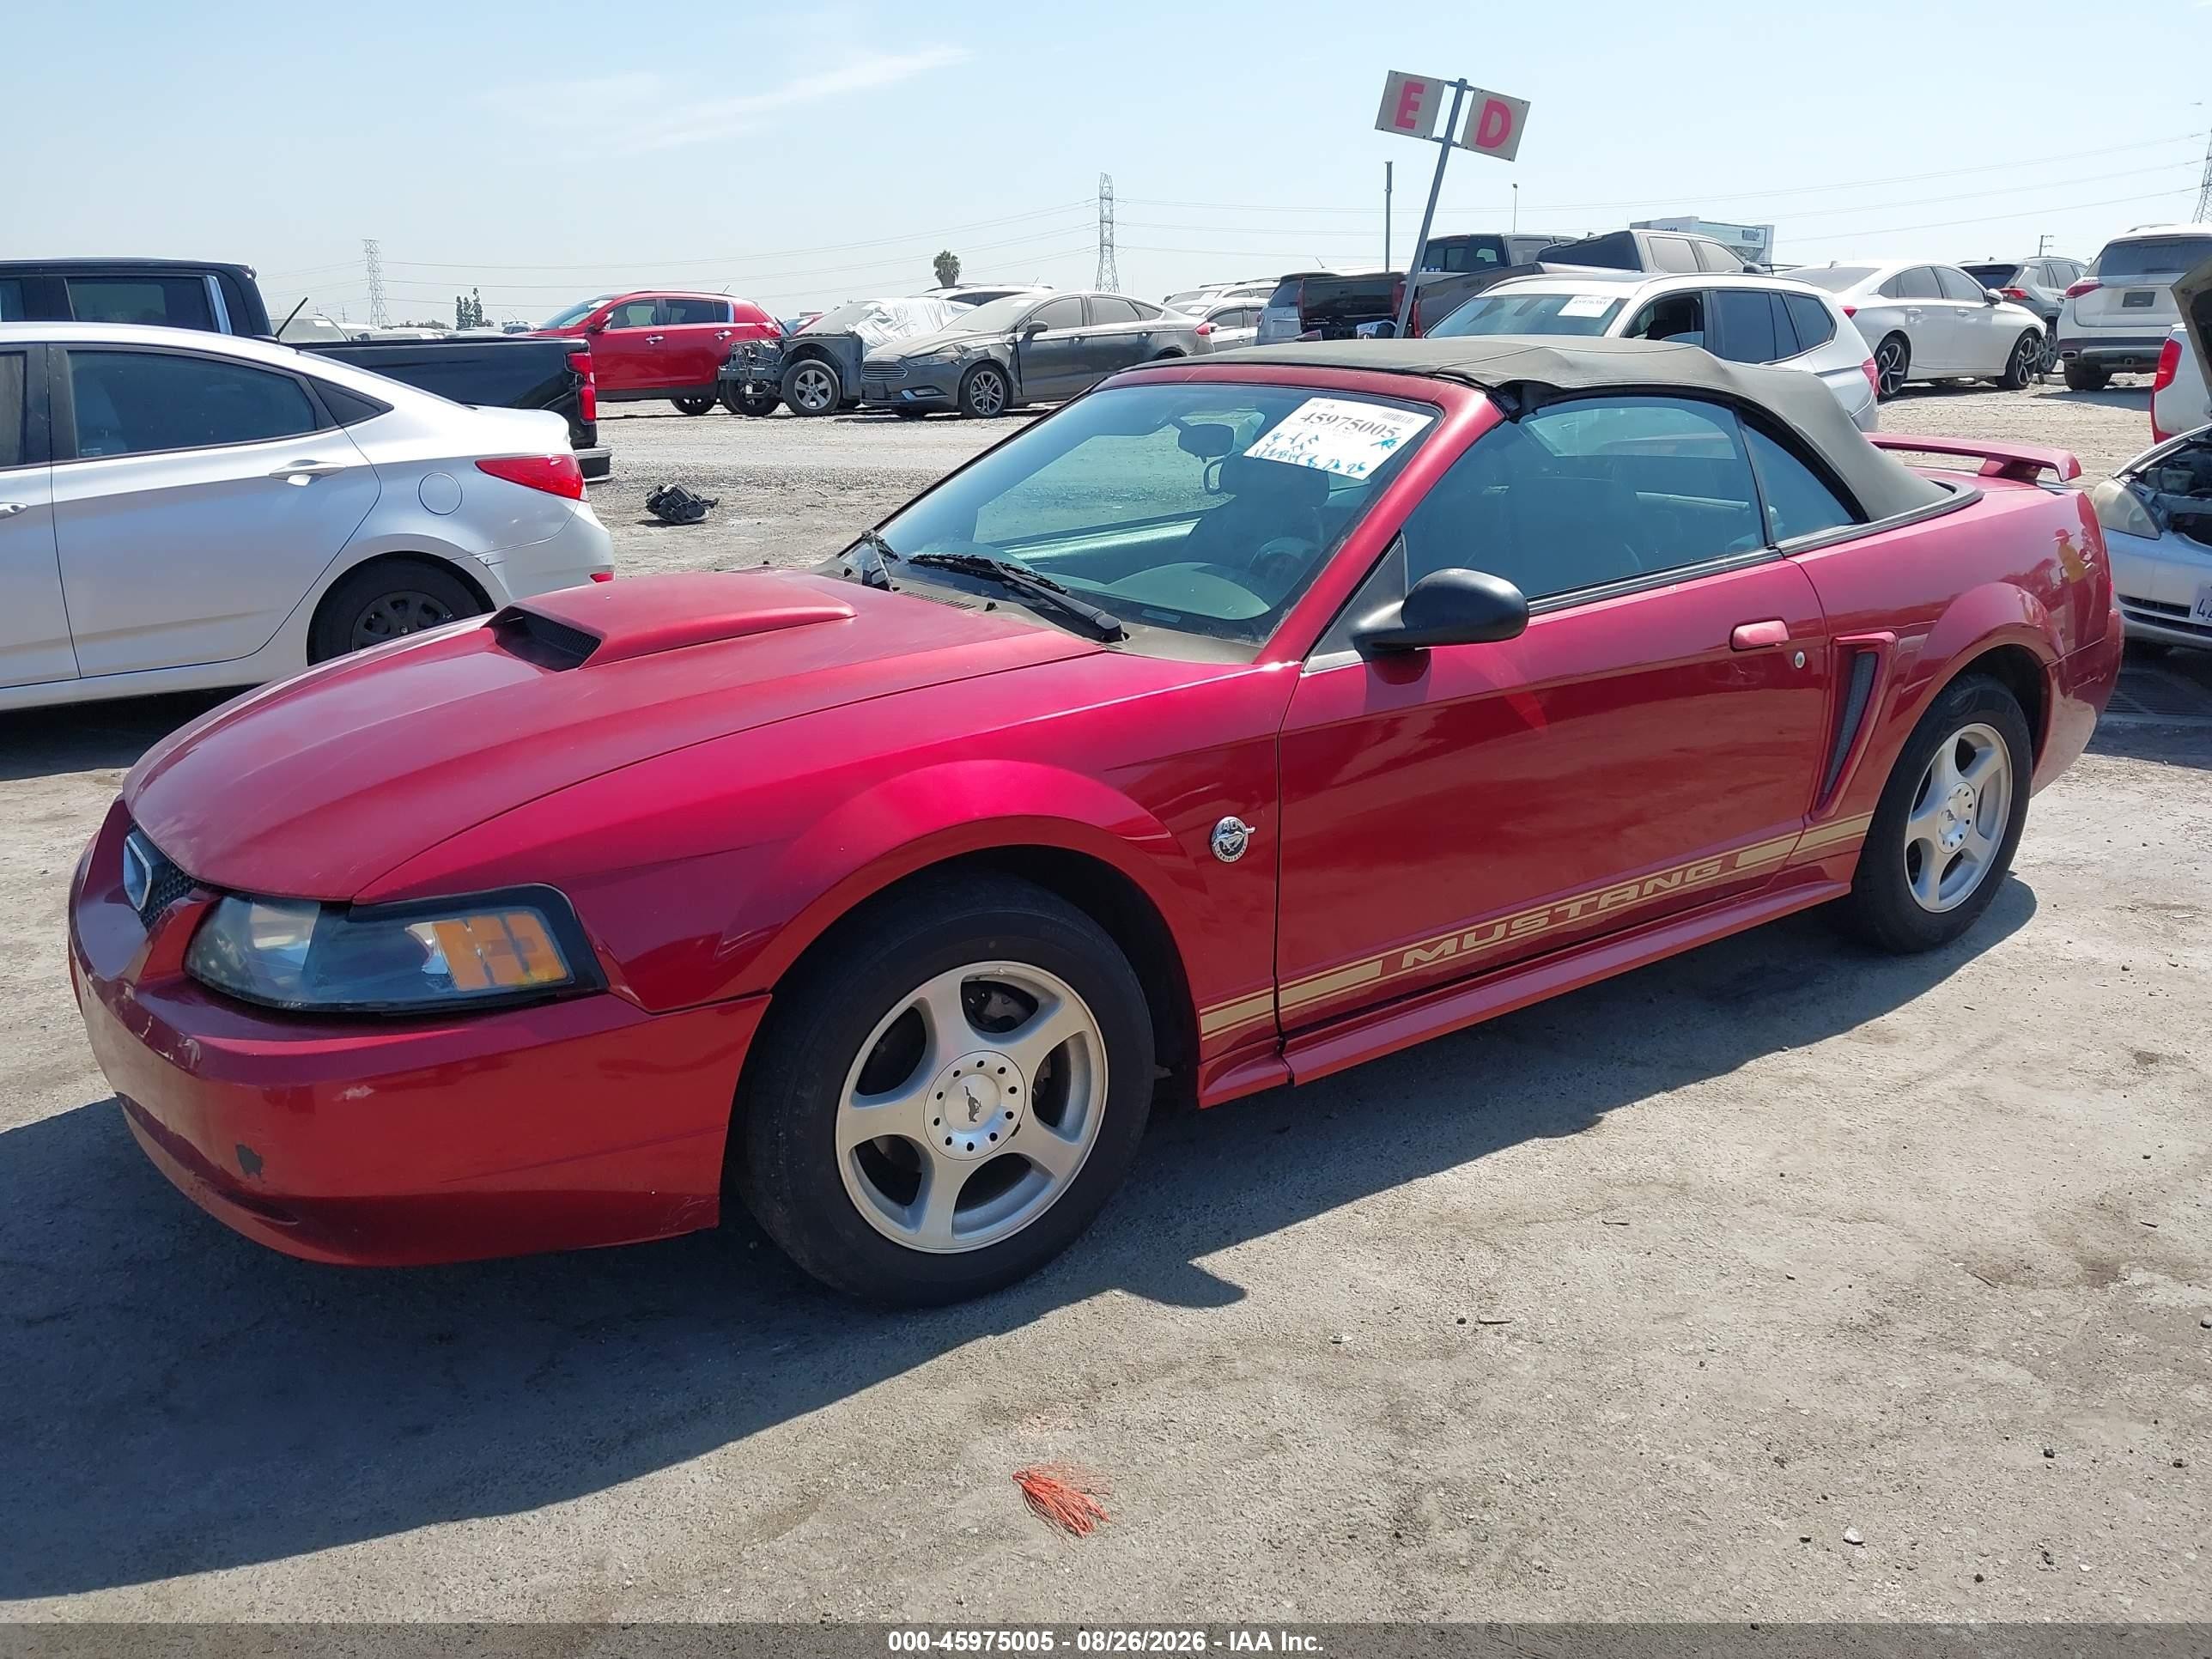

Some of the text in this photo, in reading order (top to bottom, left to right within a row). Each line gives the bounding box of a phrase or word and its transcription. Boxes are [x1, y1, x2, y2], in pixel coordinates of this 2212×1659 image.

[1394, 80, 1426, 130] E
[1475, 98, 1512, 149] D
[1299, 411, 1402, 439] 45975005
[1401, 859, 1723, 969] MUSTANG
